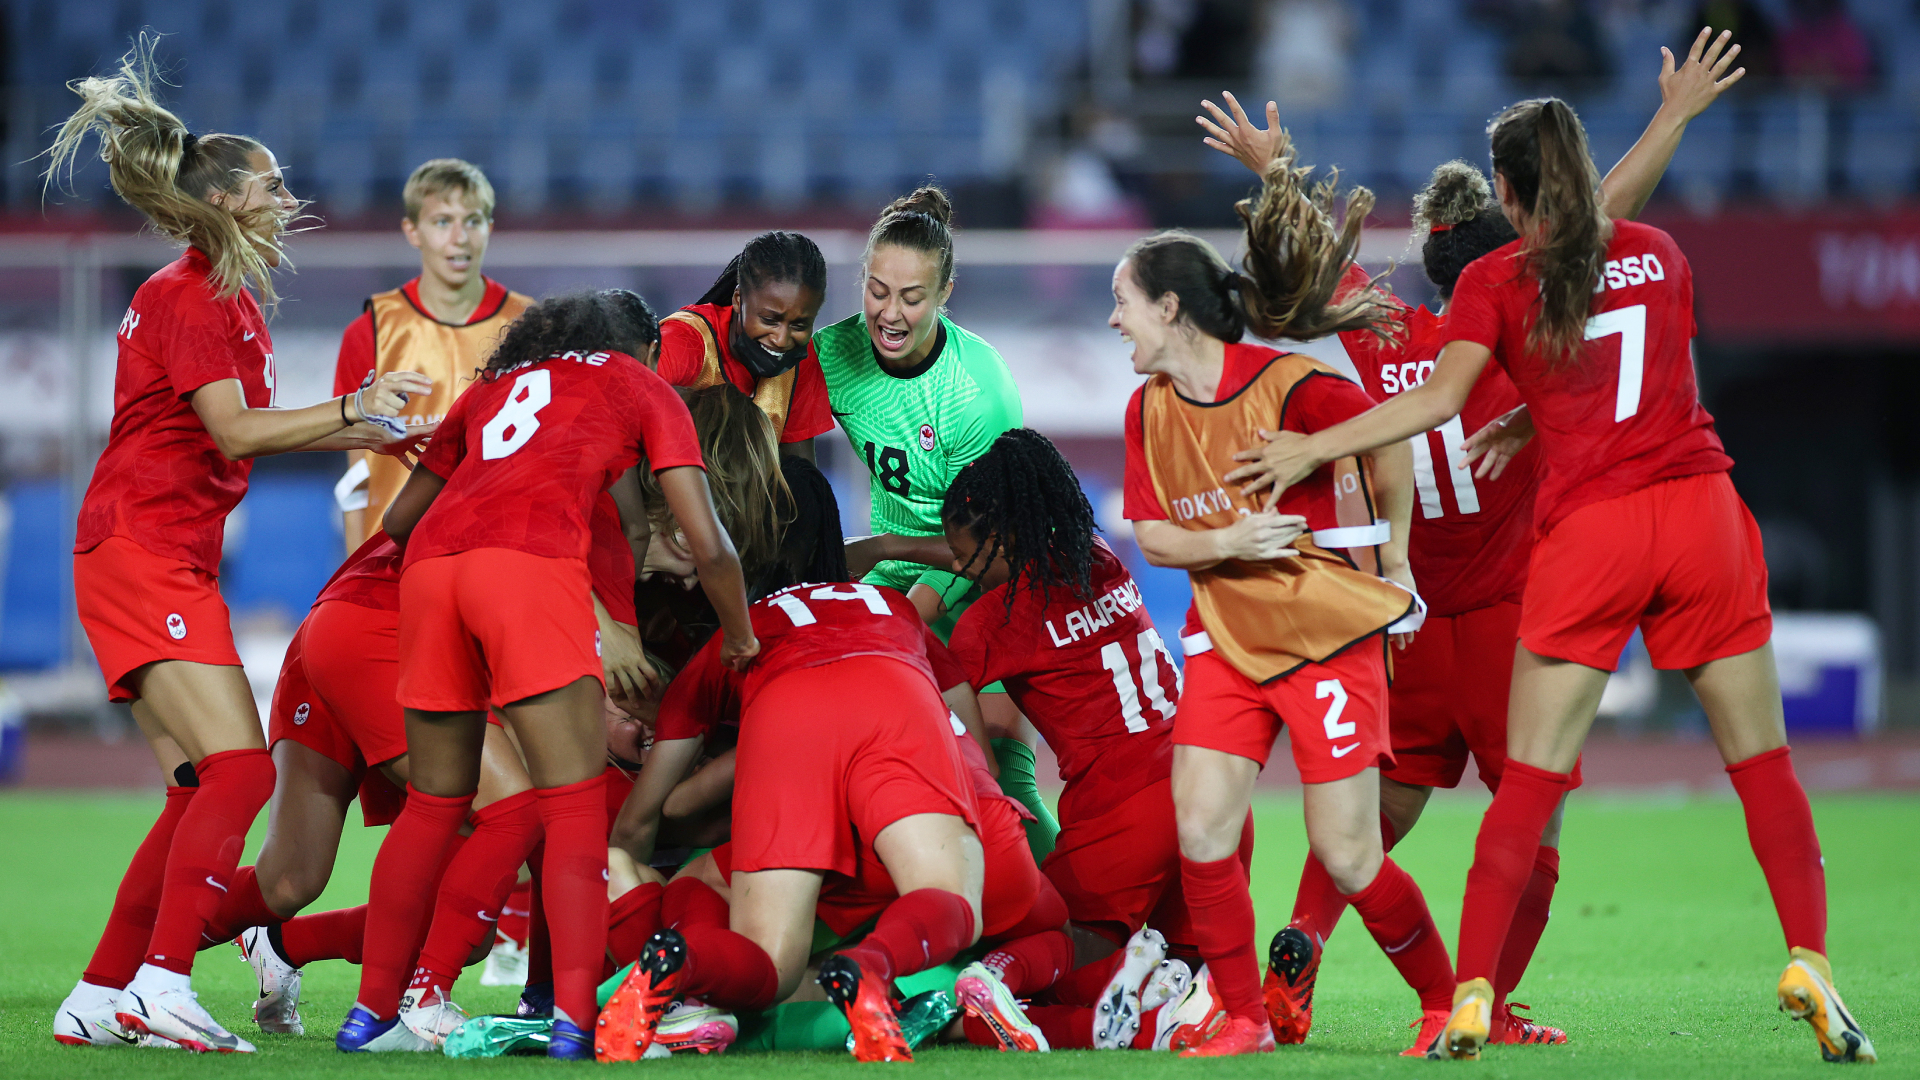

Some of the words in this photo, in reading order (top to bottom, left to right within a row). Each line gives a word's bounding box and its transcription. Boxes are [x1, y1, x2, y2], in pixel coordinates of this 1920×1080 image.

[1583, 304, 1646, 423] 7
[482, 369, 551, 461] 8
[863, 440, 911, 497] 18
[1172, 487, 1232, 521] TOKYO
[1411, 412, 1480, 520] 11
[767, 583, 893, 627] 14
[1100, 627, 1184, 734] 10
[1315, 678, 1356, 740] 2
